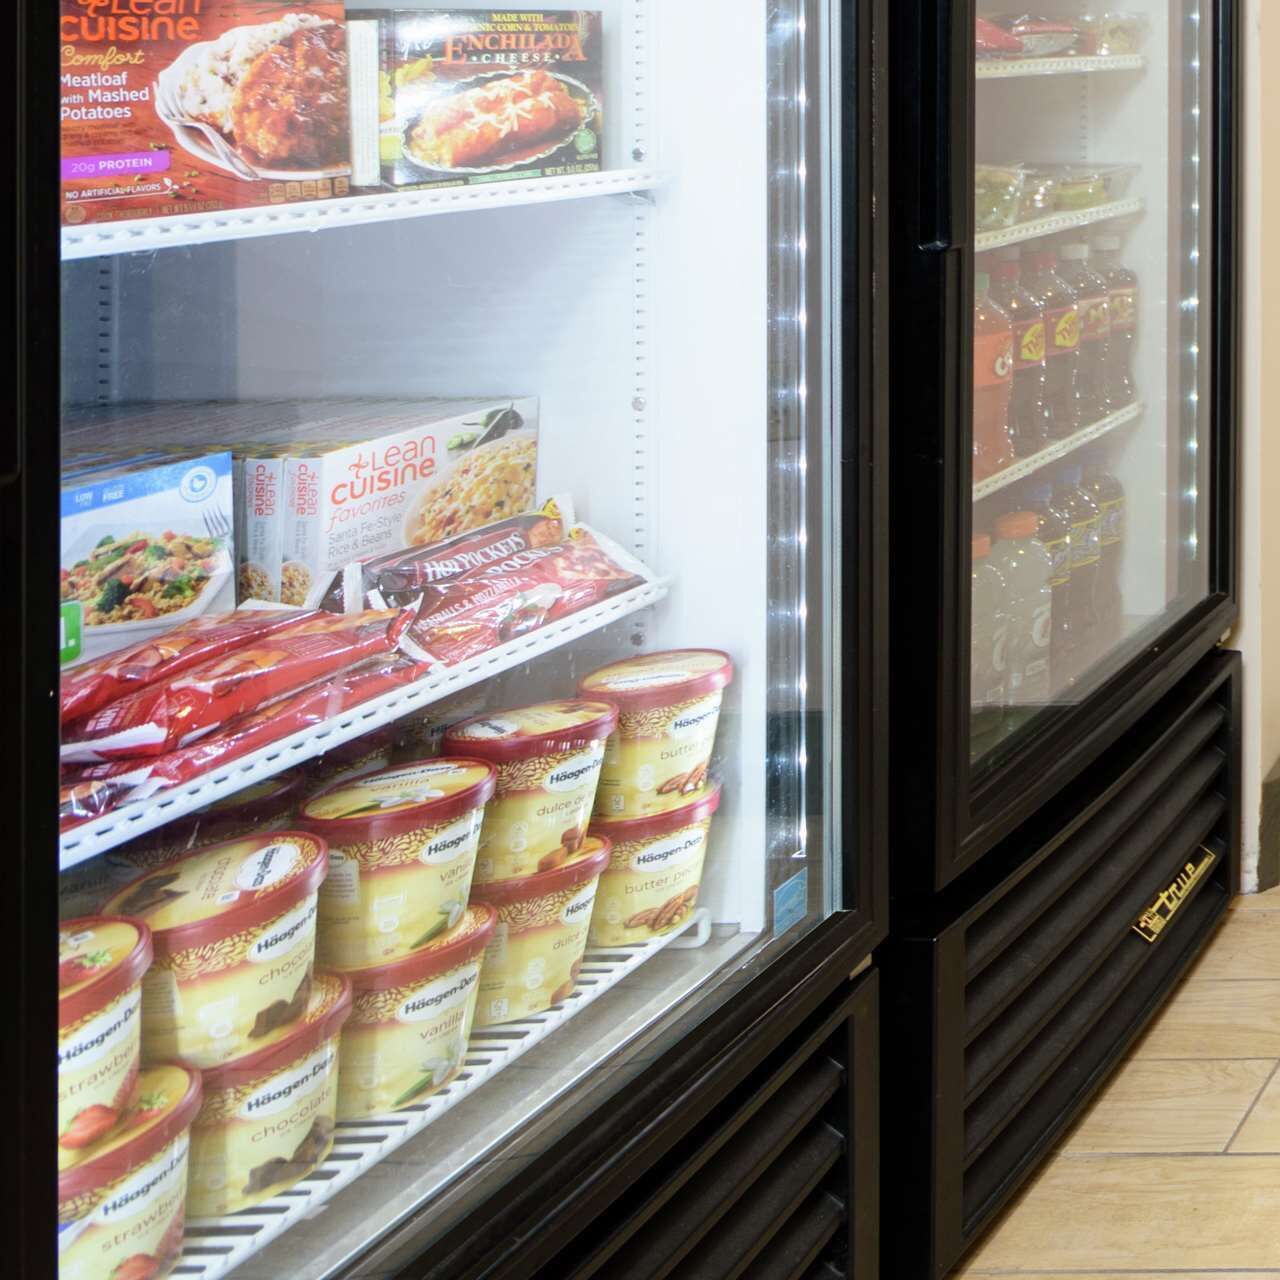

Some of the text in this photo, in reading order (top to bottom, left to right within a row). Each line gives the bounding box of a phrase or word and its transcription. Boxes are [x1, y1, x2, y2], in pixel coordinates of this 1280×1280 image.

[442, 32, 588, 65] ENCHILADA
[480, 51, 556, 64] CHEESE
[60, 71, 128, 87] Meatloaf
[88, 87, 149, 102] Mashed
[60, 105, 132, 120] Potatoes
[99, 157, 153, 170] PROTEIN
[371, 435, 436, 472] Lean
[624, 875, 670, 895] butter
